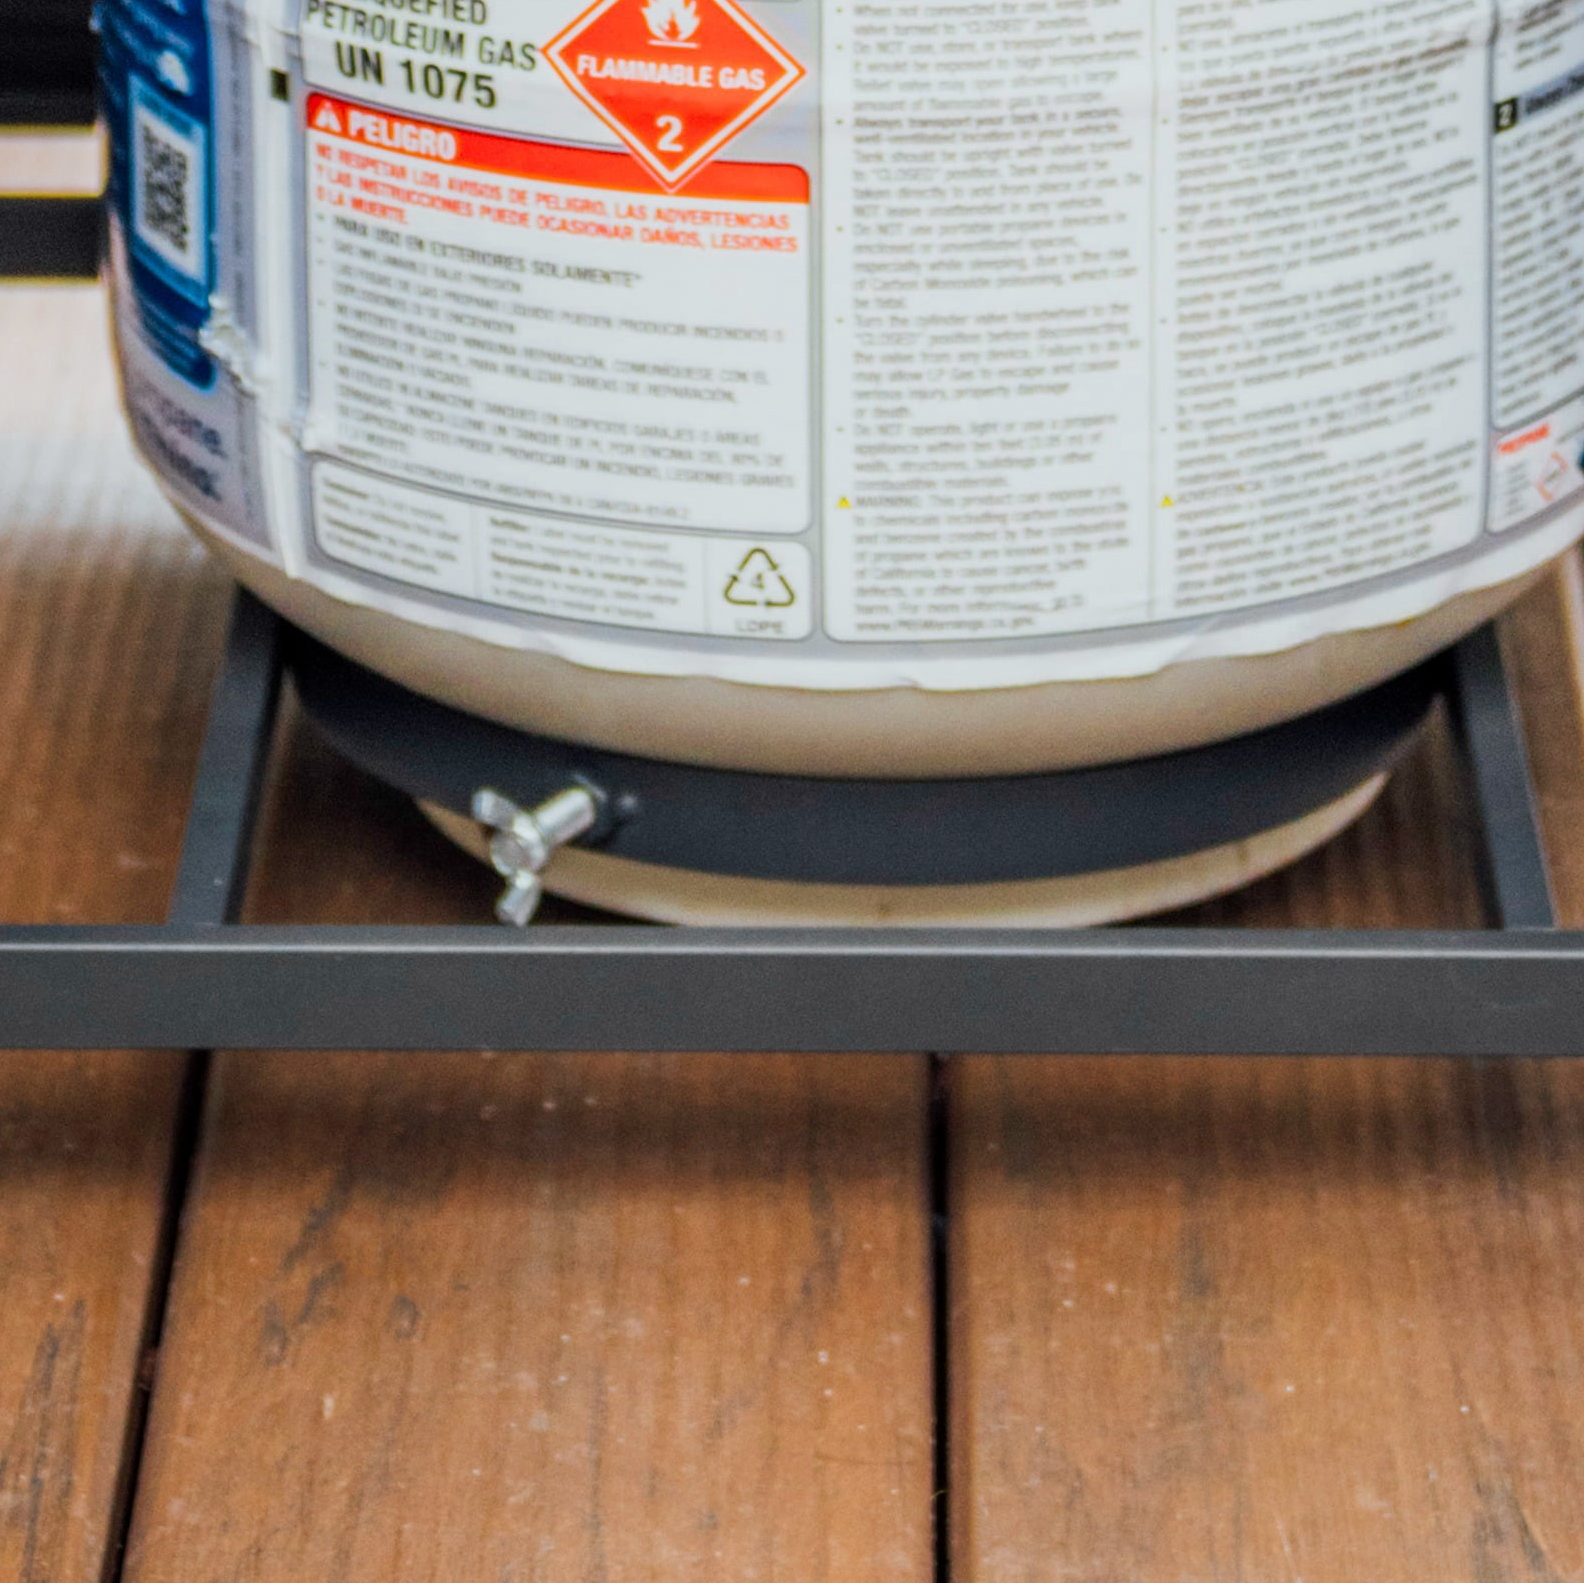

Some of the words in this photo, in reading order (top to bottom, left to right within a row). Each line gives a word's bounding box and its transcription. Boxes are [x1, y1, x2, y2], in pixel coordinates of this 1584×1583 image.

[336, 41, 385, 85] UN
[400, 58, 497, 108] 1075
[478, 36, 537, 71] GAS
[577, 54, 713, 88] FLAMMABLE
[719, 66, 766, 90] GAS
[348, 111, 457, 161] PELIGRO
[655, 115, 683, 152] 2
[337, 148, 407, 180] RESPETAR
[412, 168, 440, 189] LOS
[508, 186, 527, 205] DE
[534, 191, 610, 218] PELIGRO,
[614, 202, 647, 221] LAS
[654, 205, 789, 230] ADVERTENCIAS
[479, 203, 529, 227] PUEDE
[537, 213, 633, 241] OCASIONAR
[640, 226, 704, 249] DAÑOS,
[710, 232, 797, 252] LESIONES
